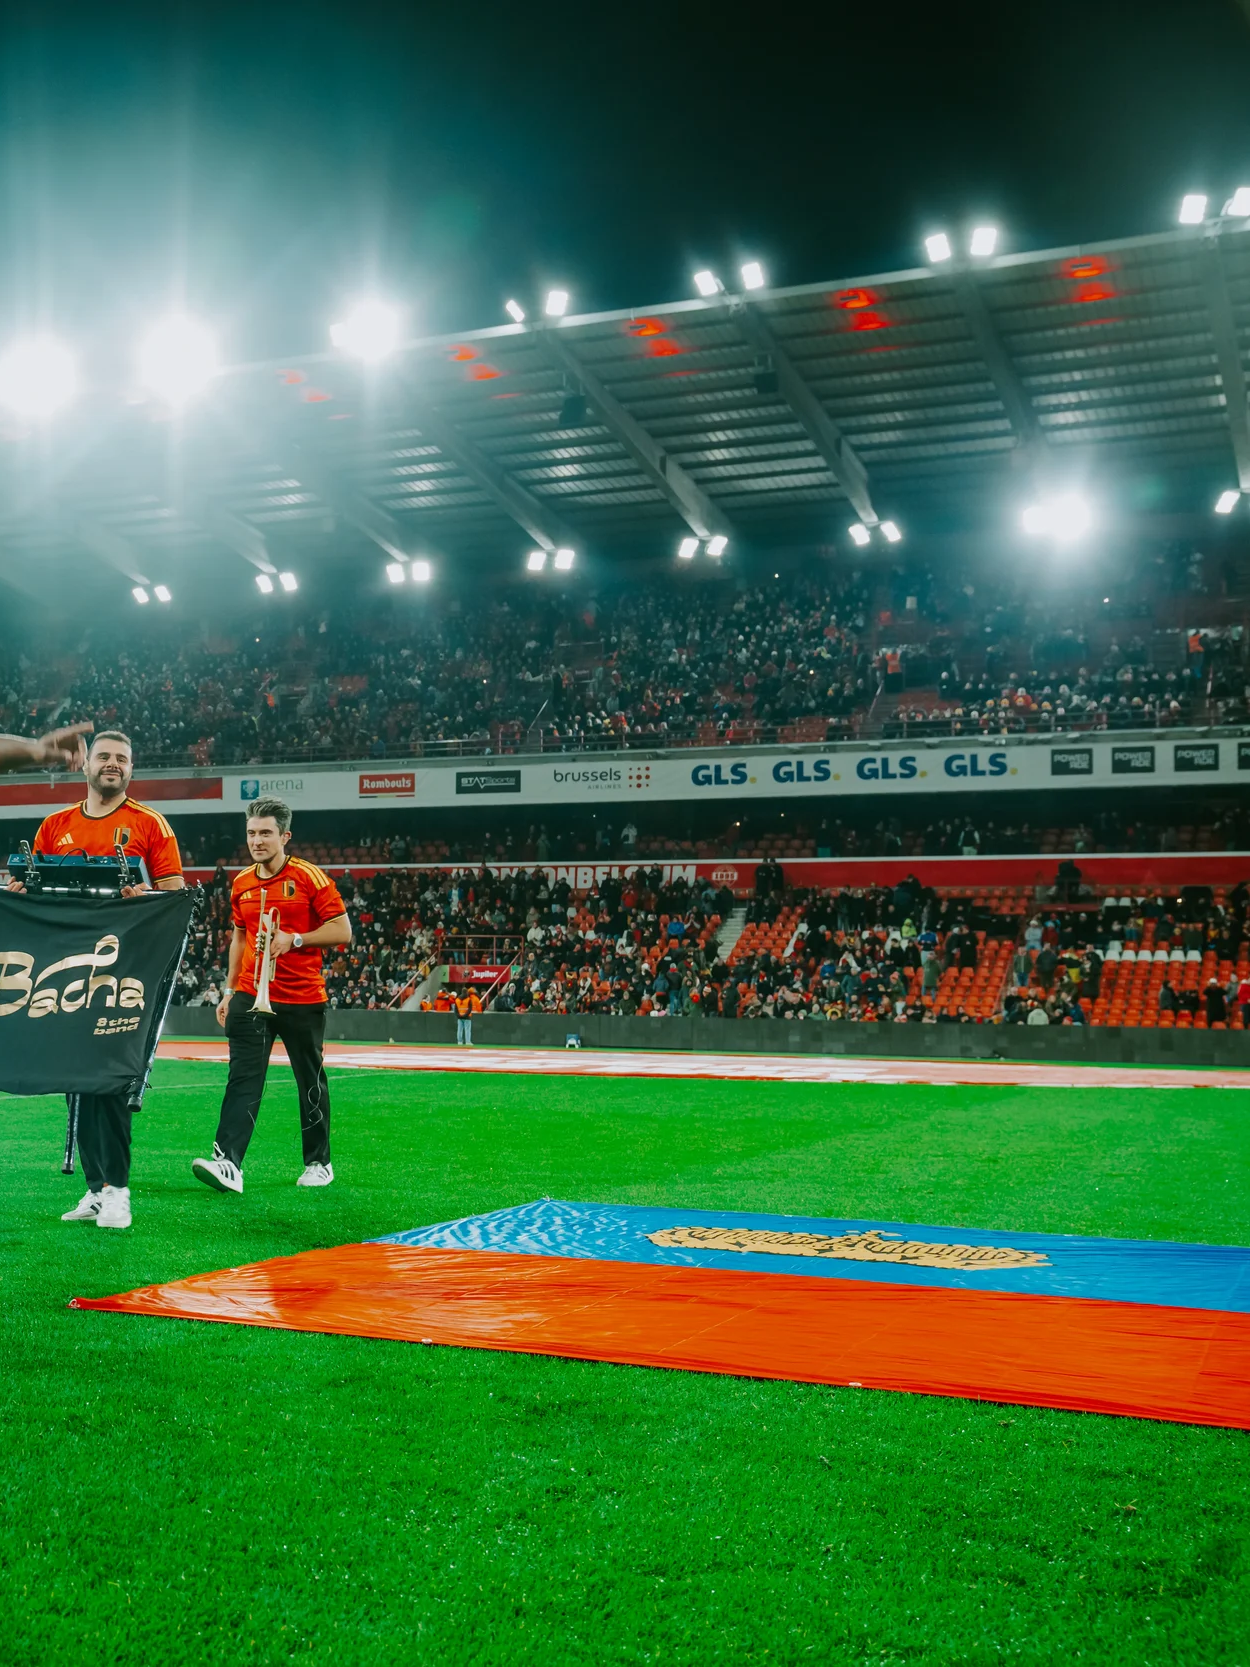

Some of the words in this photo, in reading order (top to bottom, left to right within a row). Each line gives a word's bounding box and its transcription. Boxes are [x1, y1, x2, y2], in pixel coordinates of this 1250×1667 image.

[1053, 753, 1090, 763] POWER
[1113, 751, 1152, 761] POWER
[1176, 749, 1216, 759] POWER
[553, 767, 622, 783] brussels
[260, 779, 304, 791] arena
[362, 776, 412, 789] Rombouts
[471, 969, 499, 979] Jupiler
[108, 1016, 141, 1027] the
[93, 1022, 139, 1036] band
